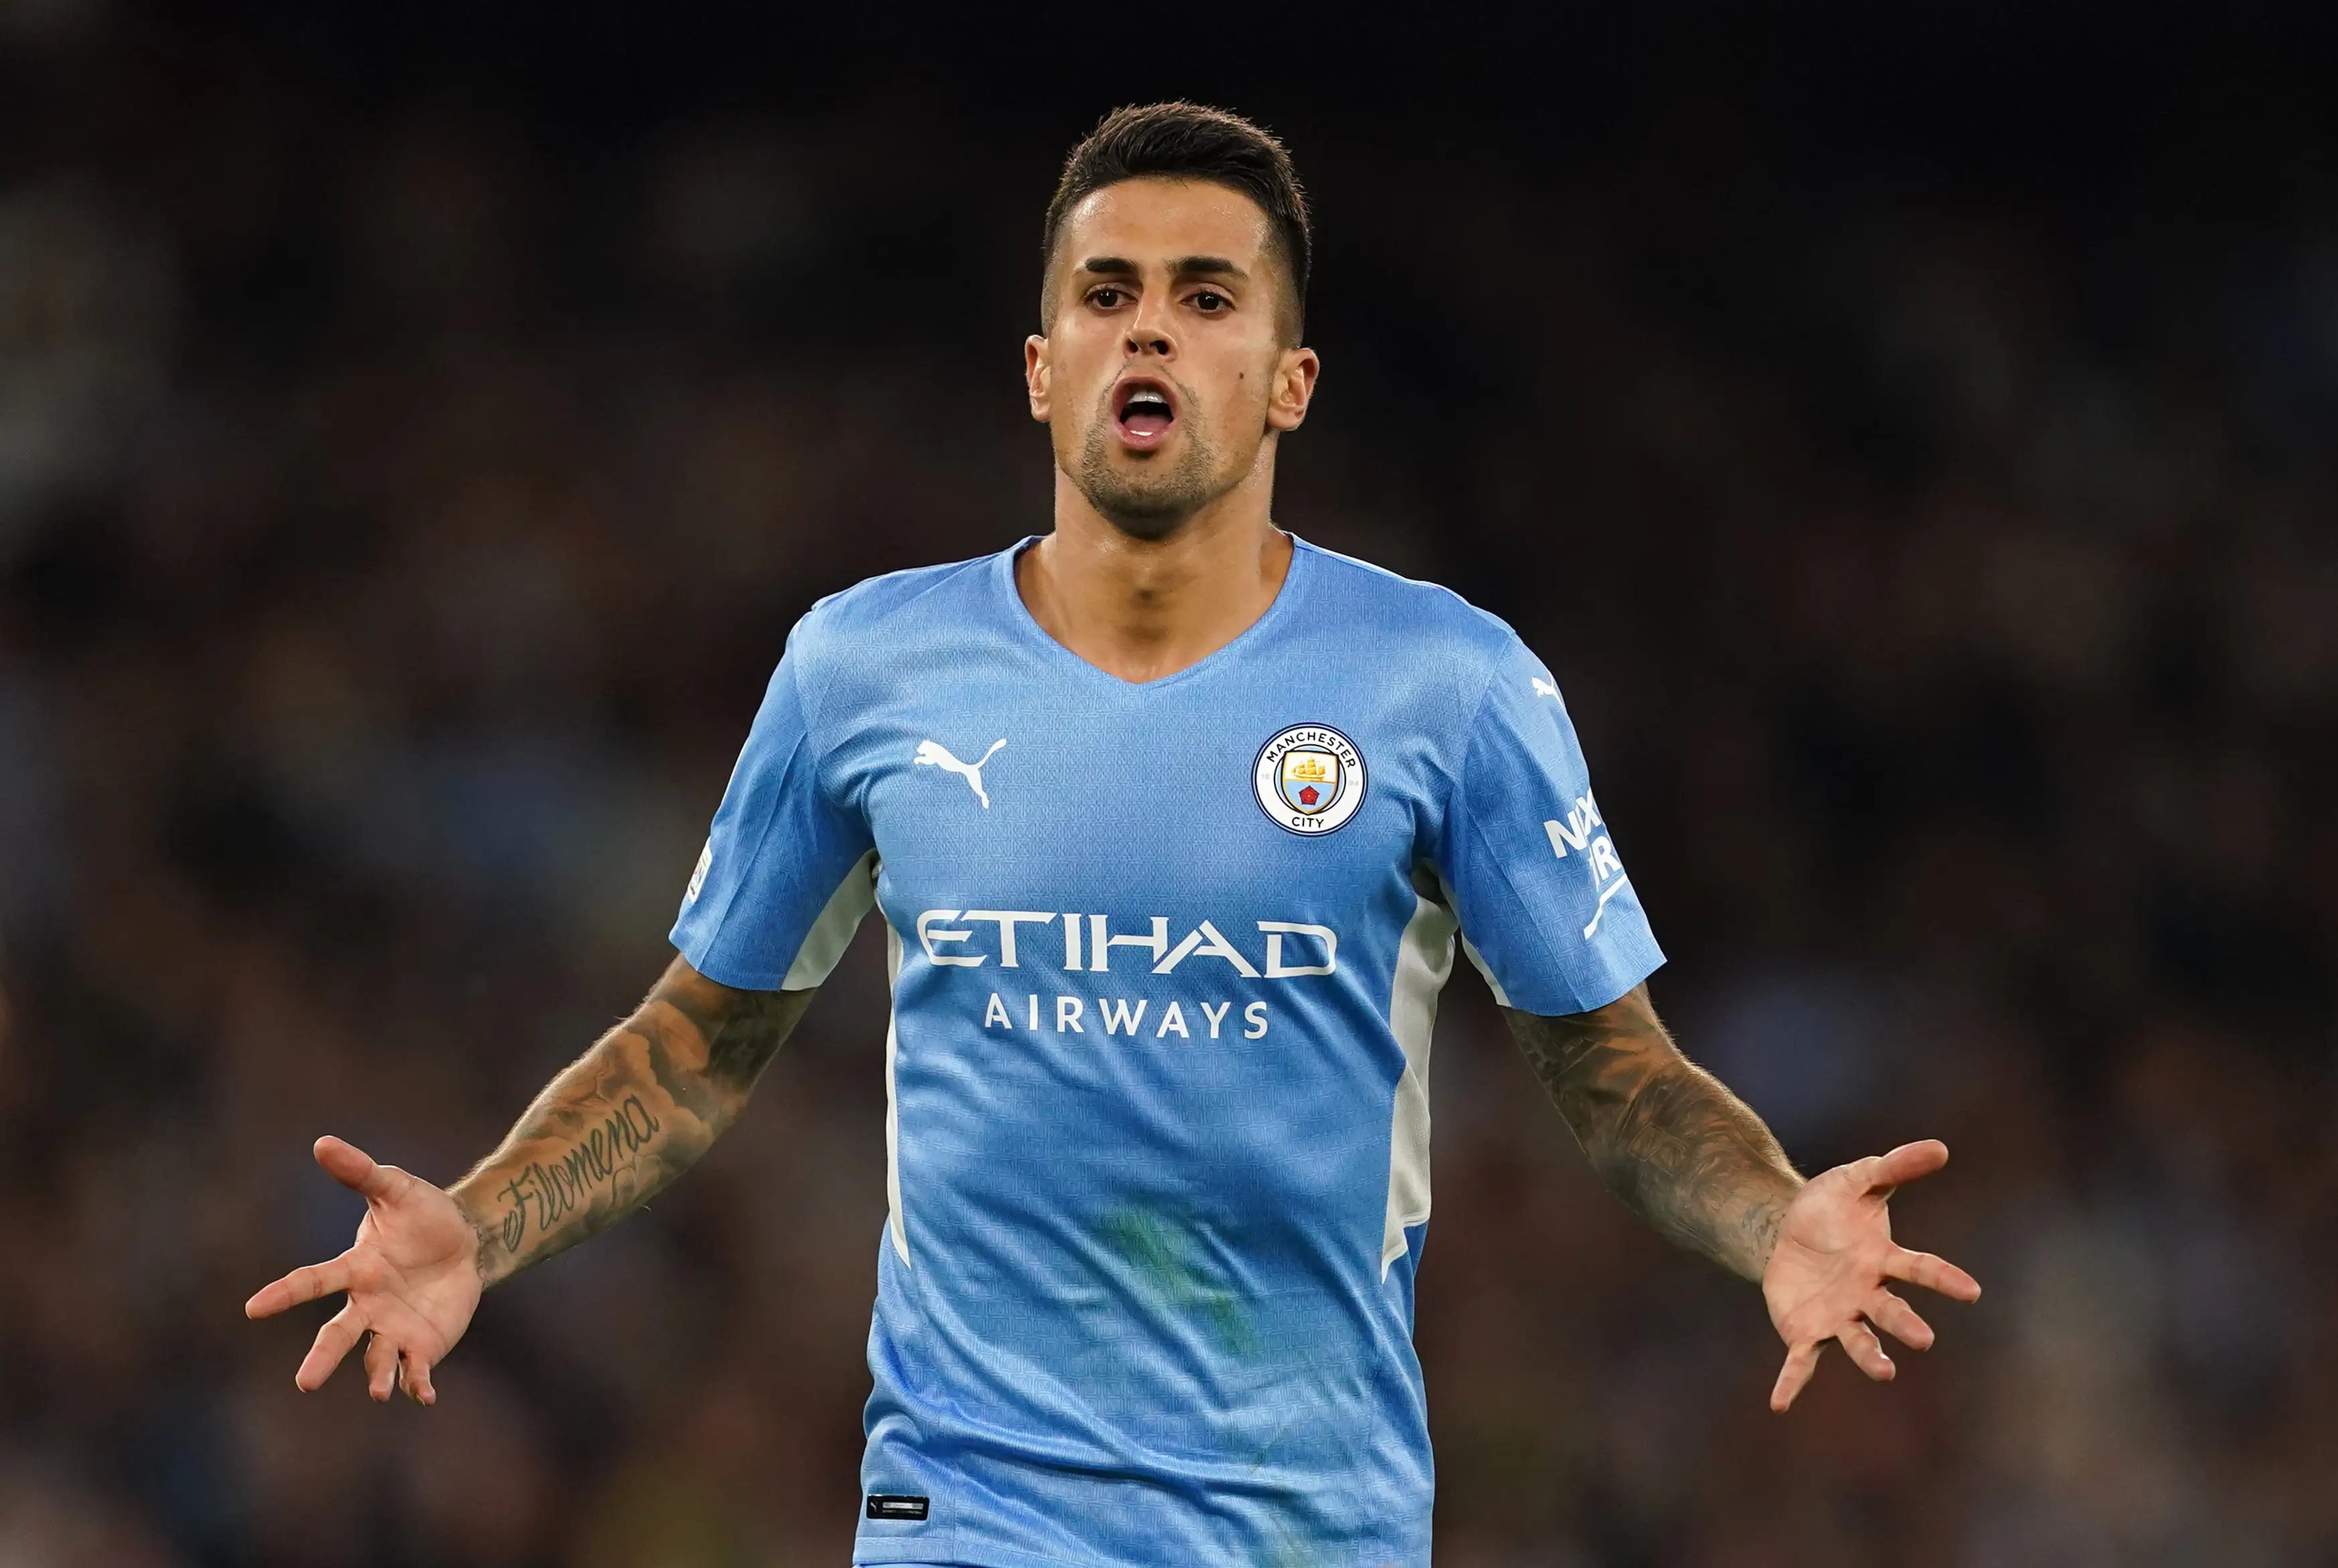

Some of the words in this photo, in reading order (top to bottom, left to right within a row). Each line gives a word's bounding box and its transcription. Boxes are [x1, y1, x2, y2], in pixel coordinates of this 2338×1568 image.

[1266, 731, 1356, 768] MANCHESTER
[1292, 816, 1325, 829] CITY
[917, 909, 1337, 978] ETIHAD
[985, 992, 1268, 1039] AIRWAYS
[497, 1094, 659, 1253] Filomena
